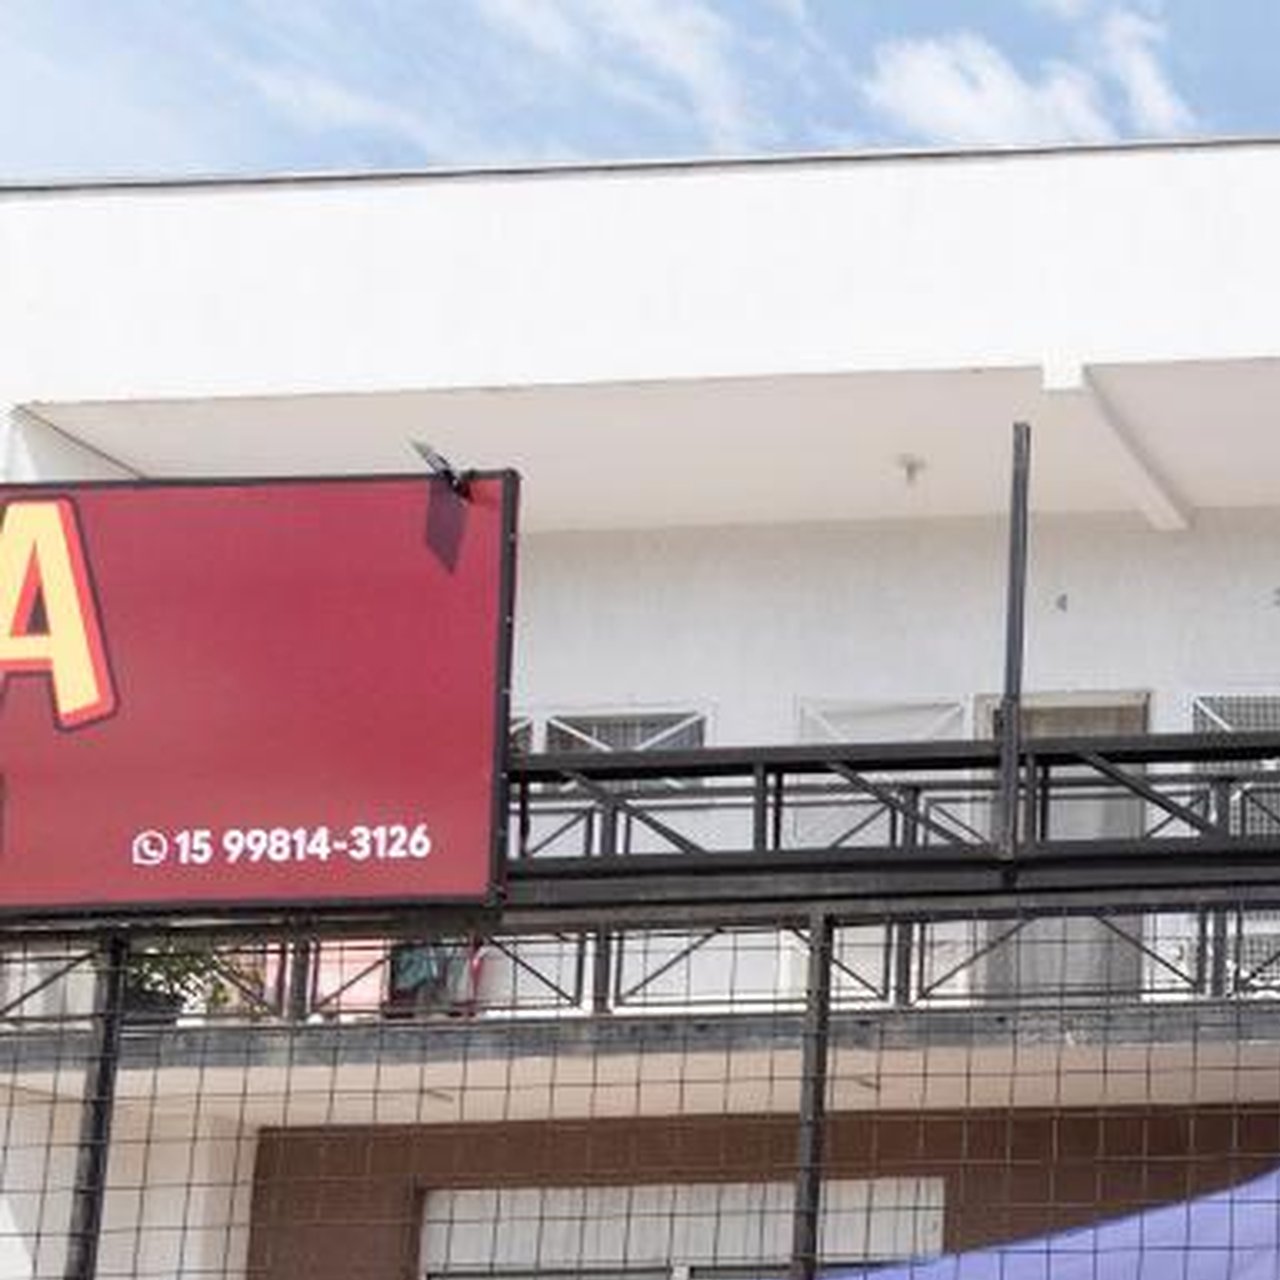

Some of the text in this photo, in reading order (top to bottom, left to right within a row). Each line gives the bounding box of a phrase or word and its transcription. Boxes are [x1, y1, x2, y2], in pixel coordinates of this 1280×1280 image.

[0, 498, 118, 730] A
[174, 824, 432, 864] 15 99814-3126
